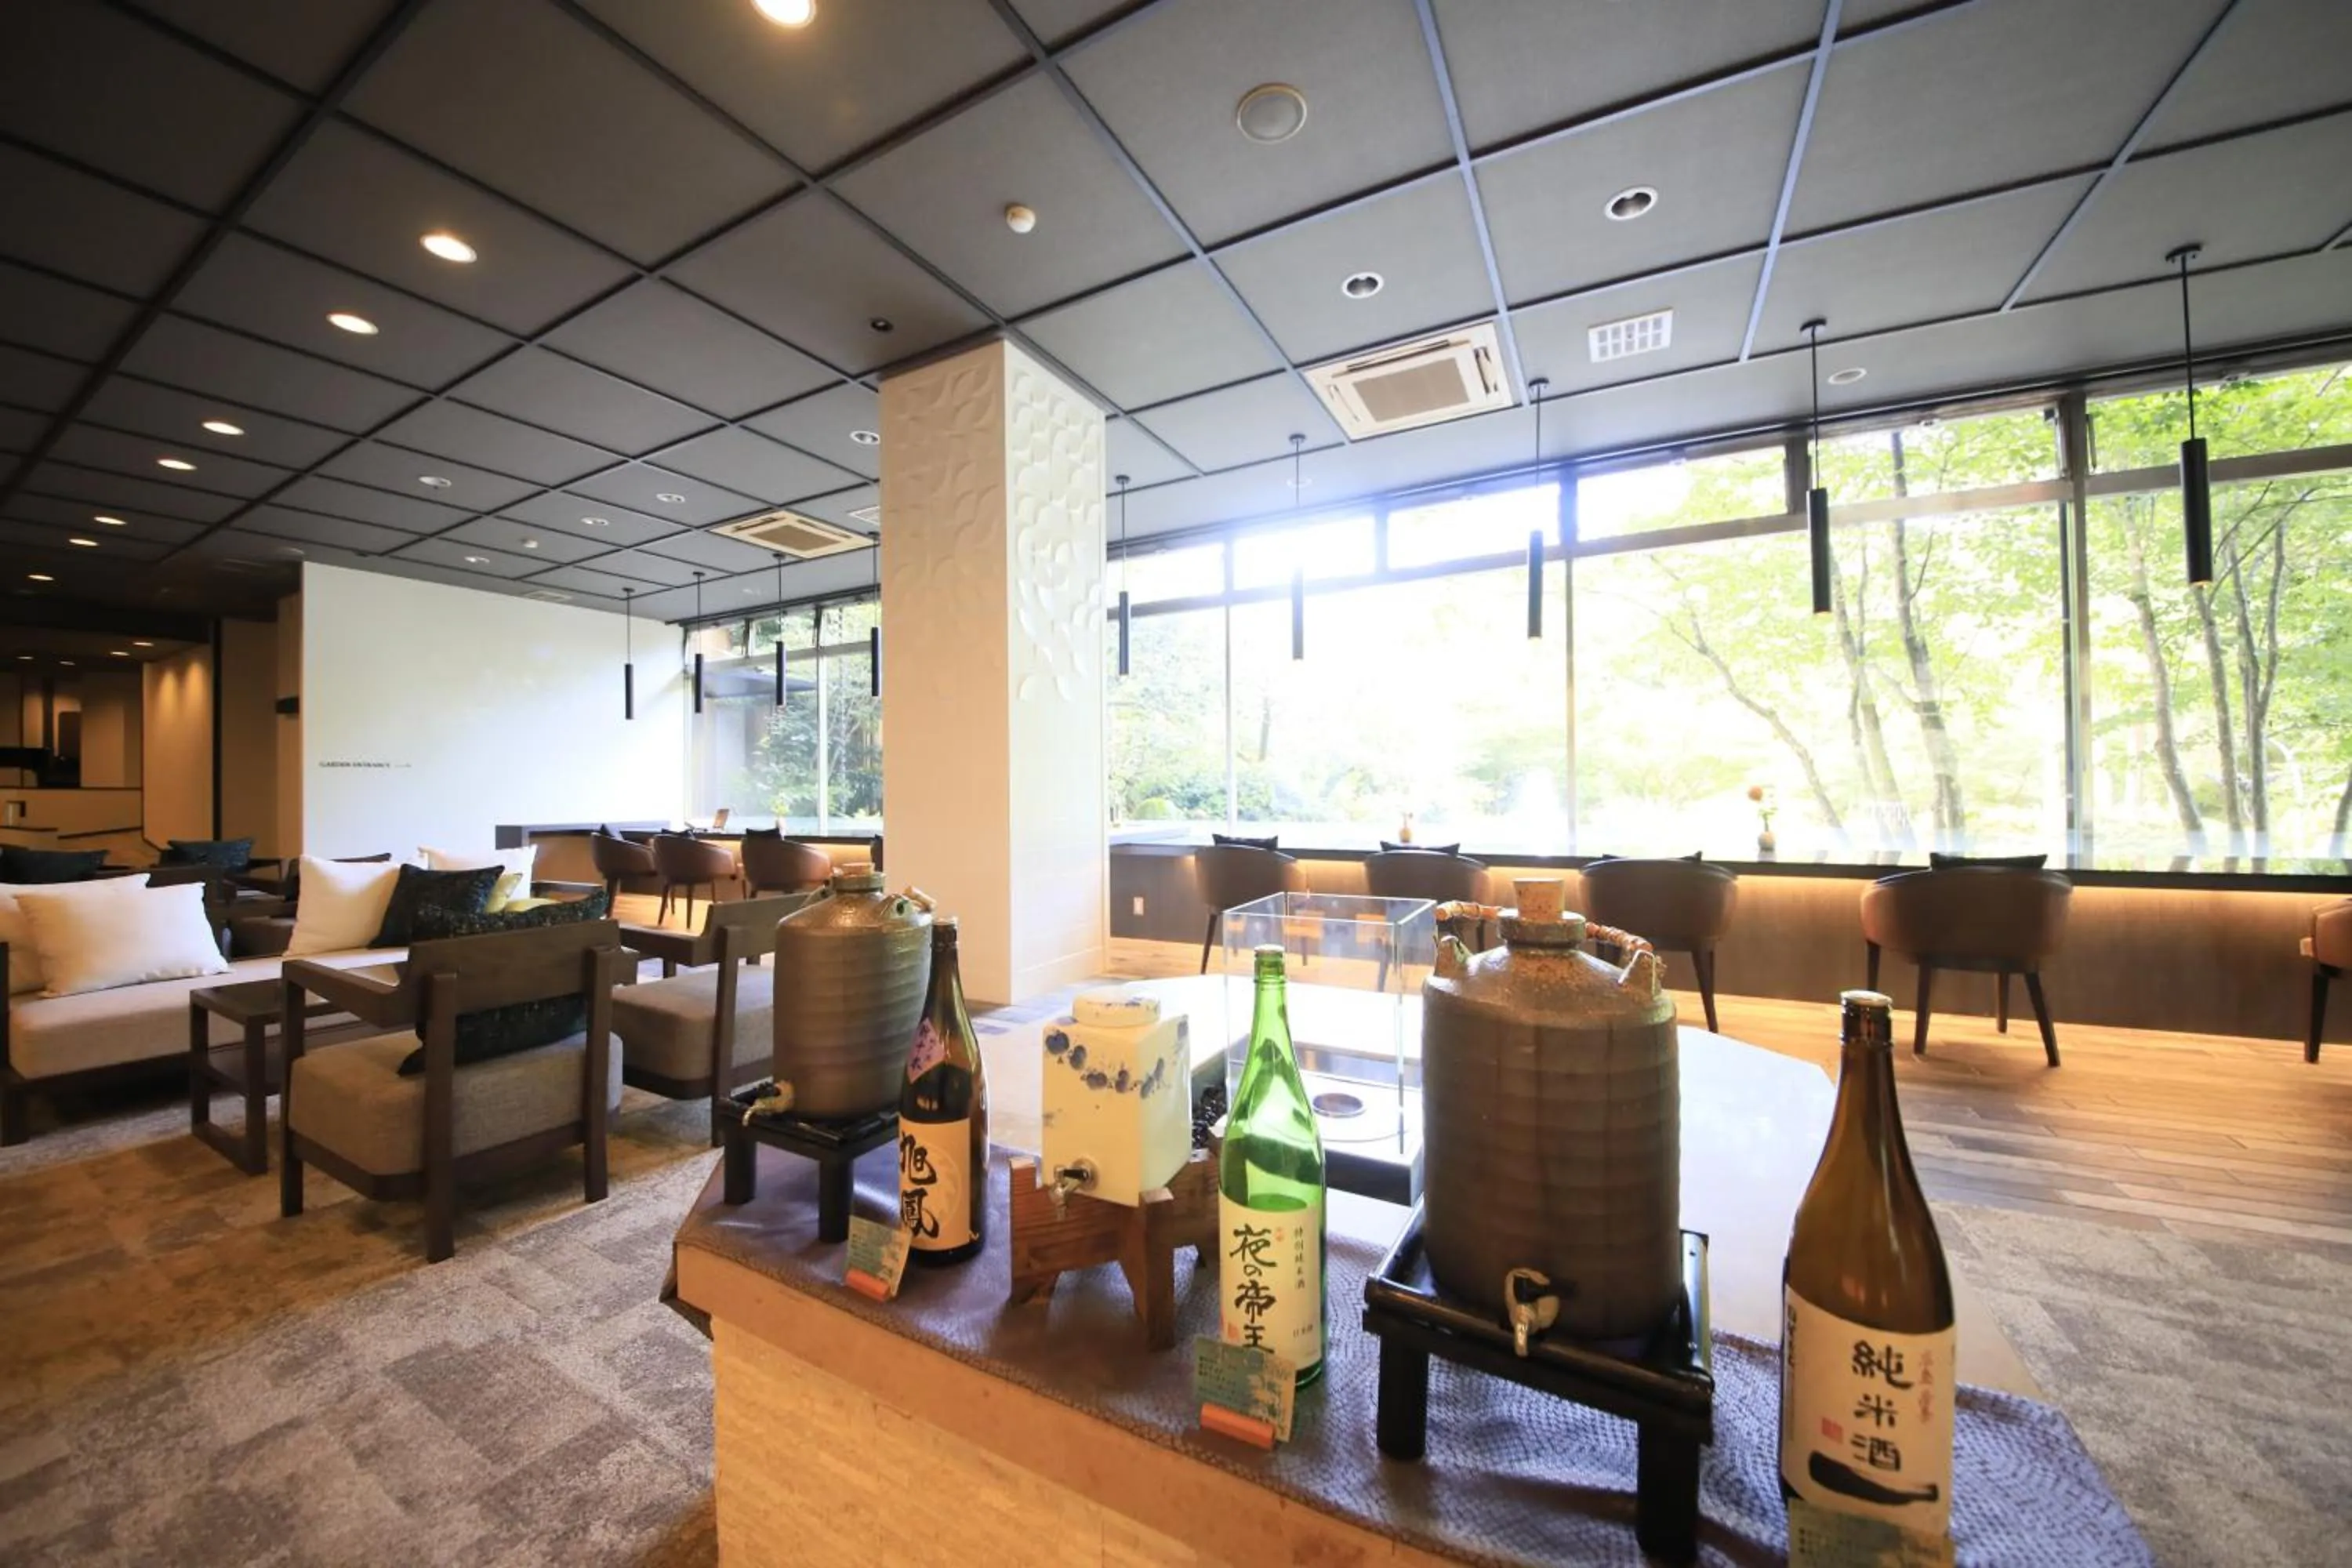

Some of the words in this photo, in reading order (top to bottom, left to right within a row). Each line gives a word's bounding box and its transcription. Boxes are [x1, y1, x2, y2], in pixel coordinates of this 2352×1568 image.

[899, 1131, 939, 1240] 旭鳳
[1229, 1223, 1278, 1354] 夜の帝王
[1849, 1339, 1915, 1472] 純米酒
